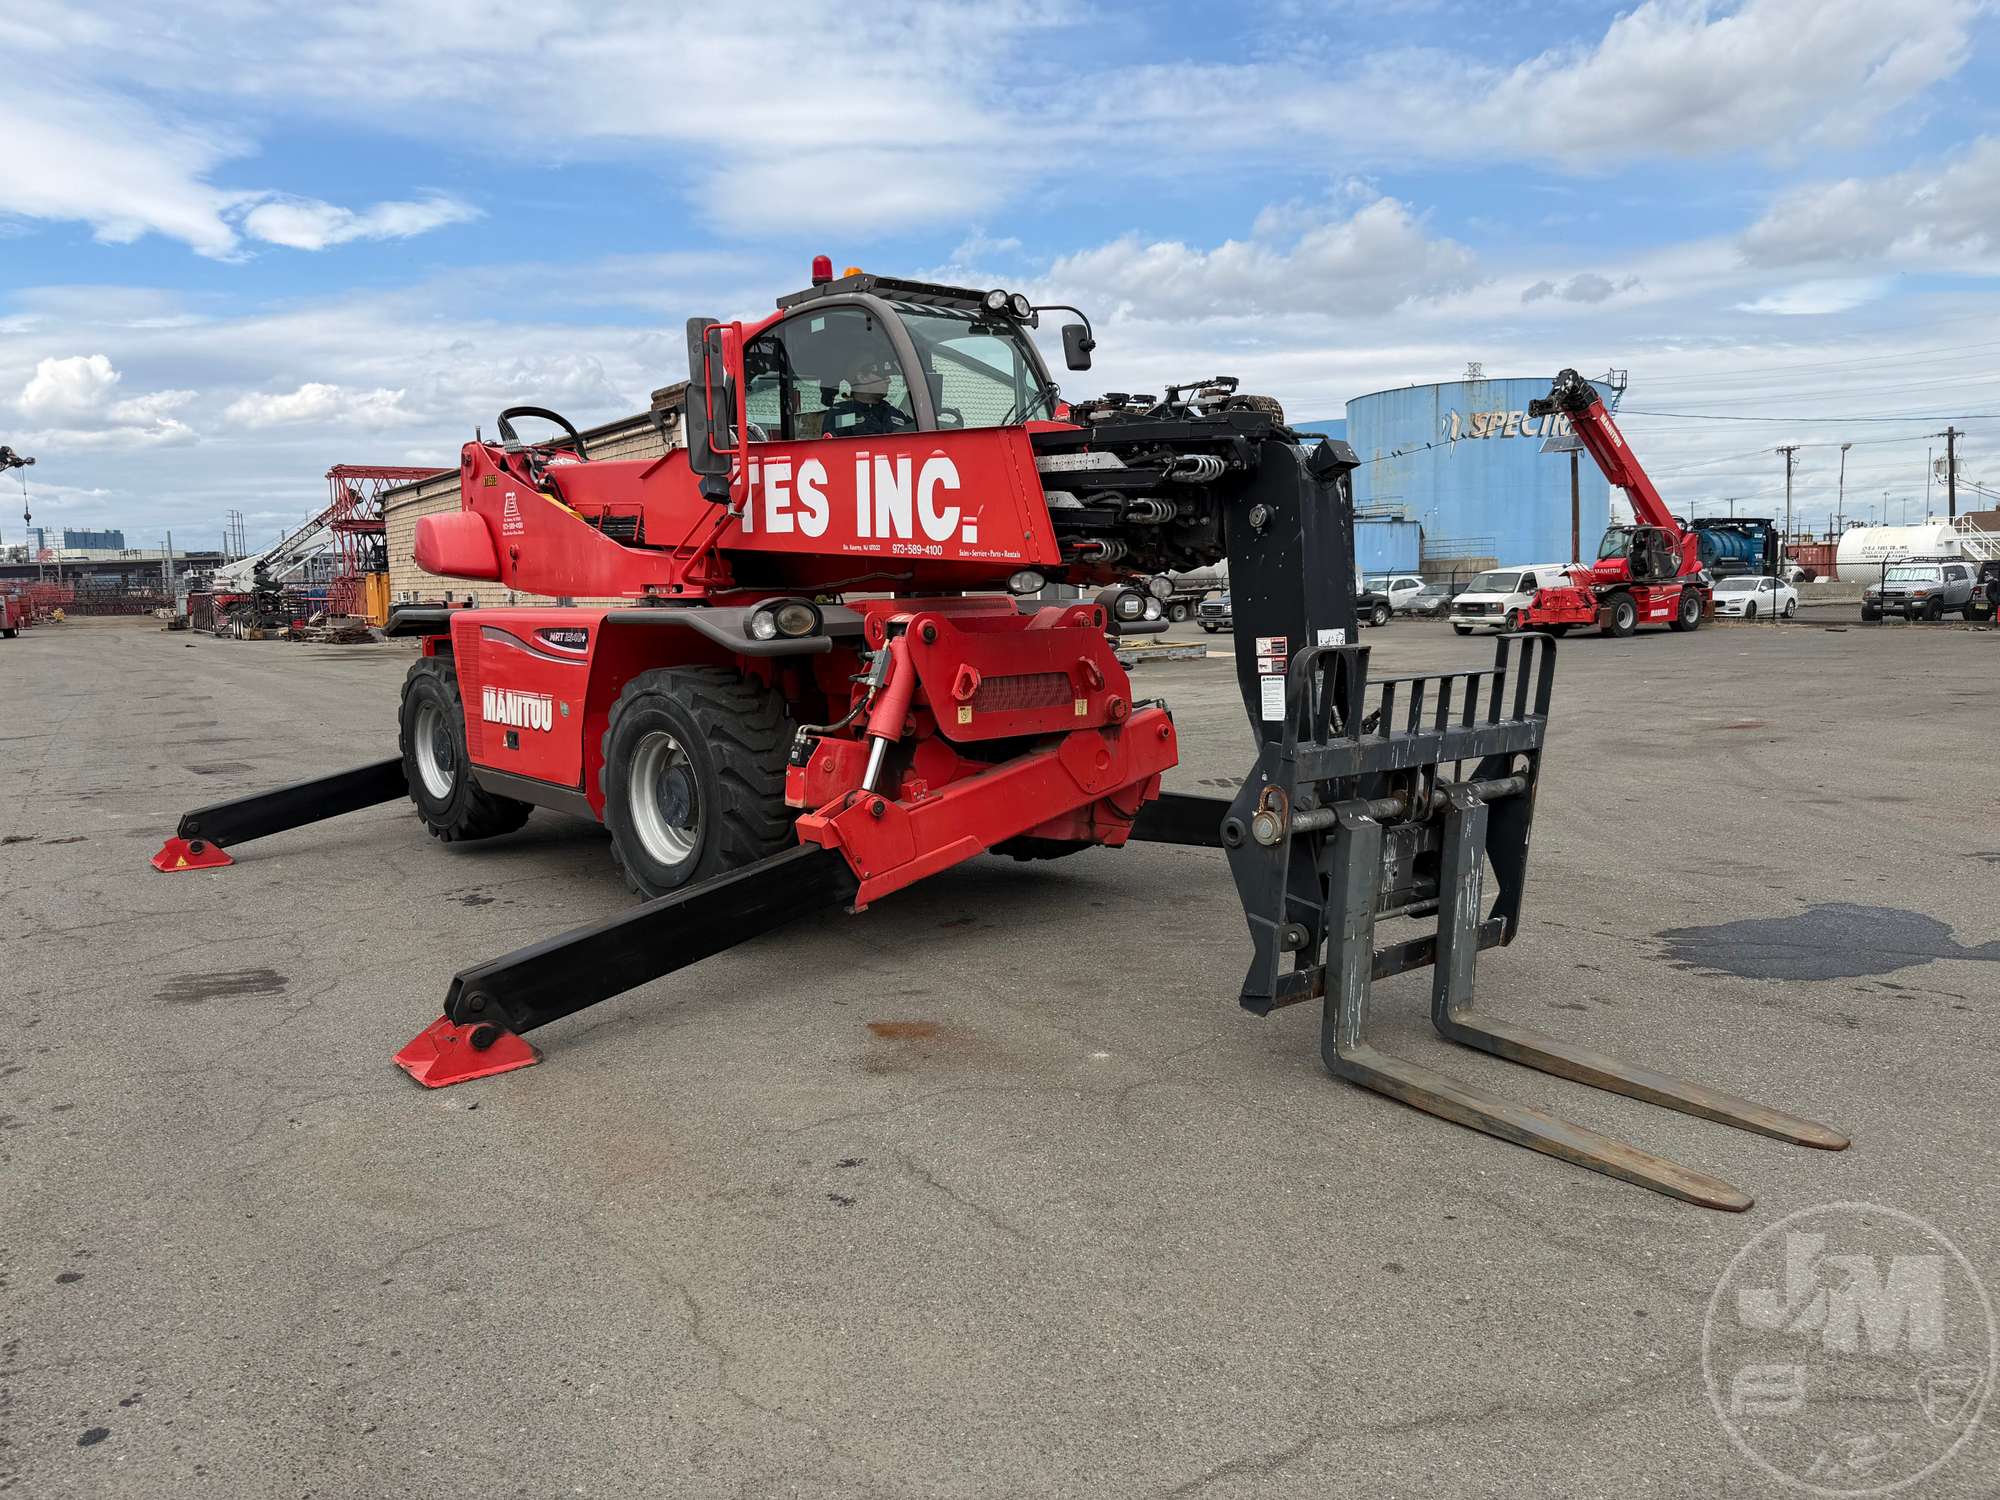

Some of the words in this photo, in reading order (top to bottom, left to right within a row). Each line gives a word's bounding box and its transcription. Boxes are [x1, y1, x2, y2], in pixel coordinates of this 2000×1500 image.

[1469, 410, 1578, 438] SPECTR
[1599, 412, 1622, 448] MANITOU
[855, 450, 978, 544] INC.
[892, 543, 943, 556] 973-589-4100
[481, 686, 553, 732] MANITOU
